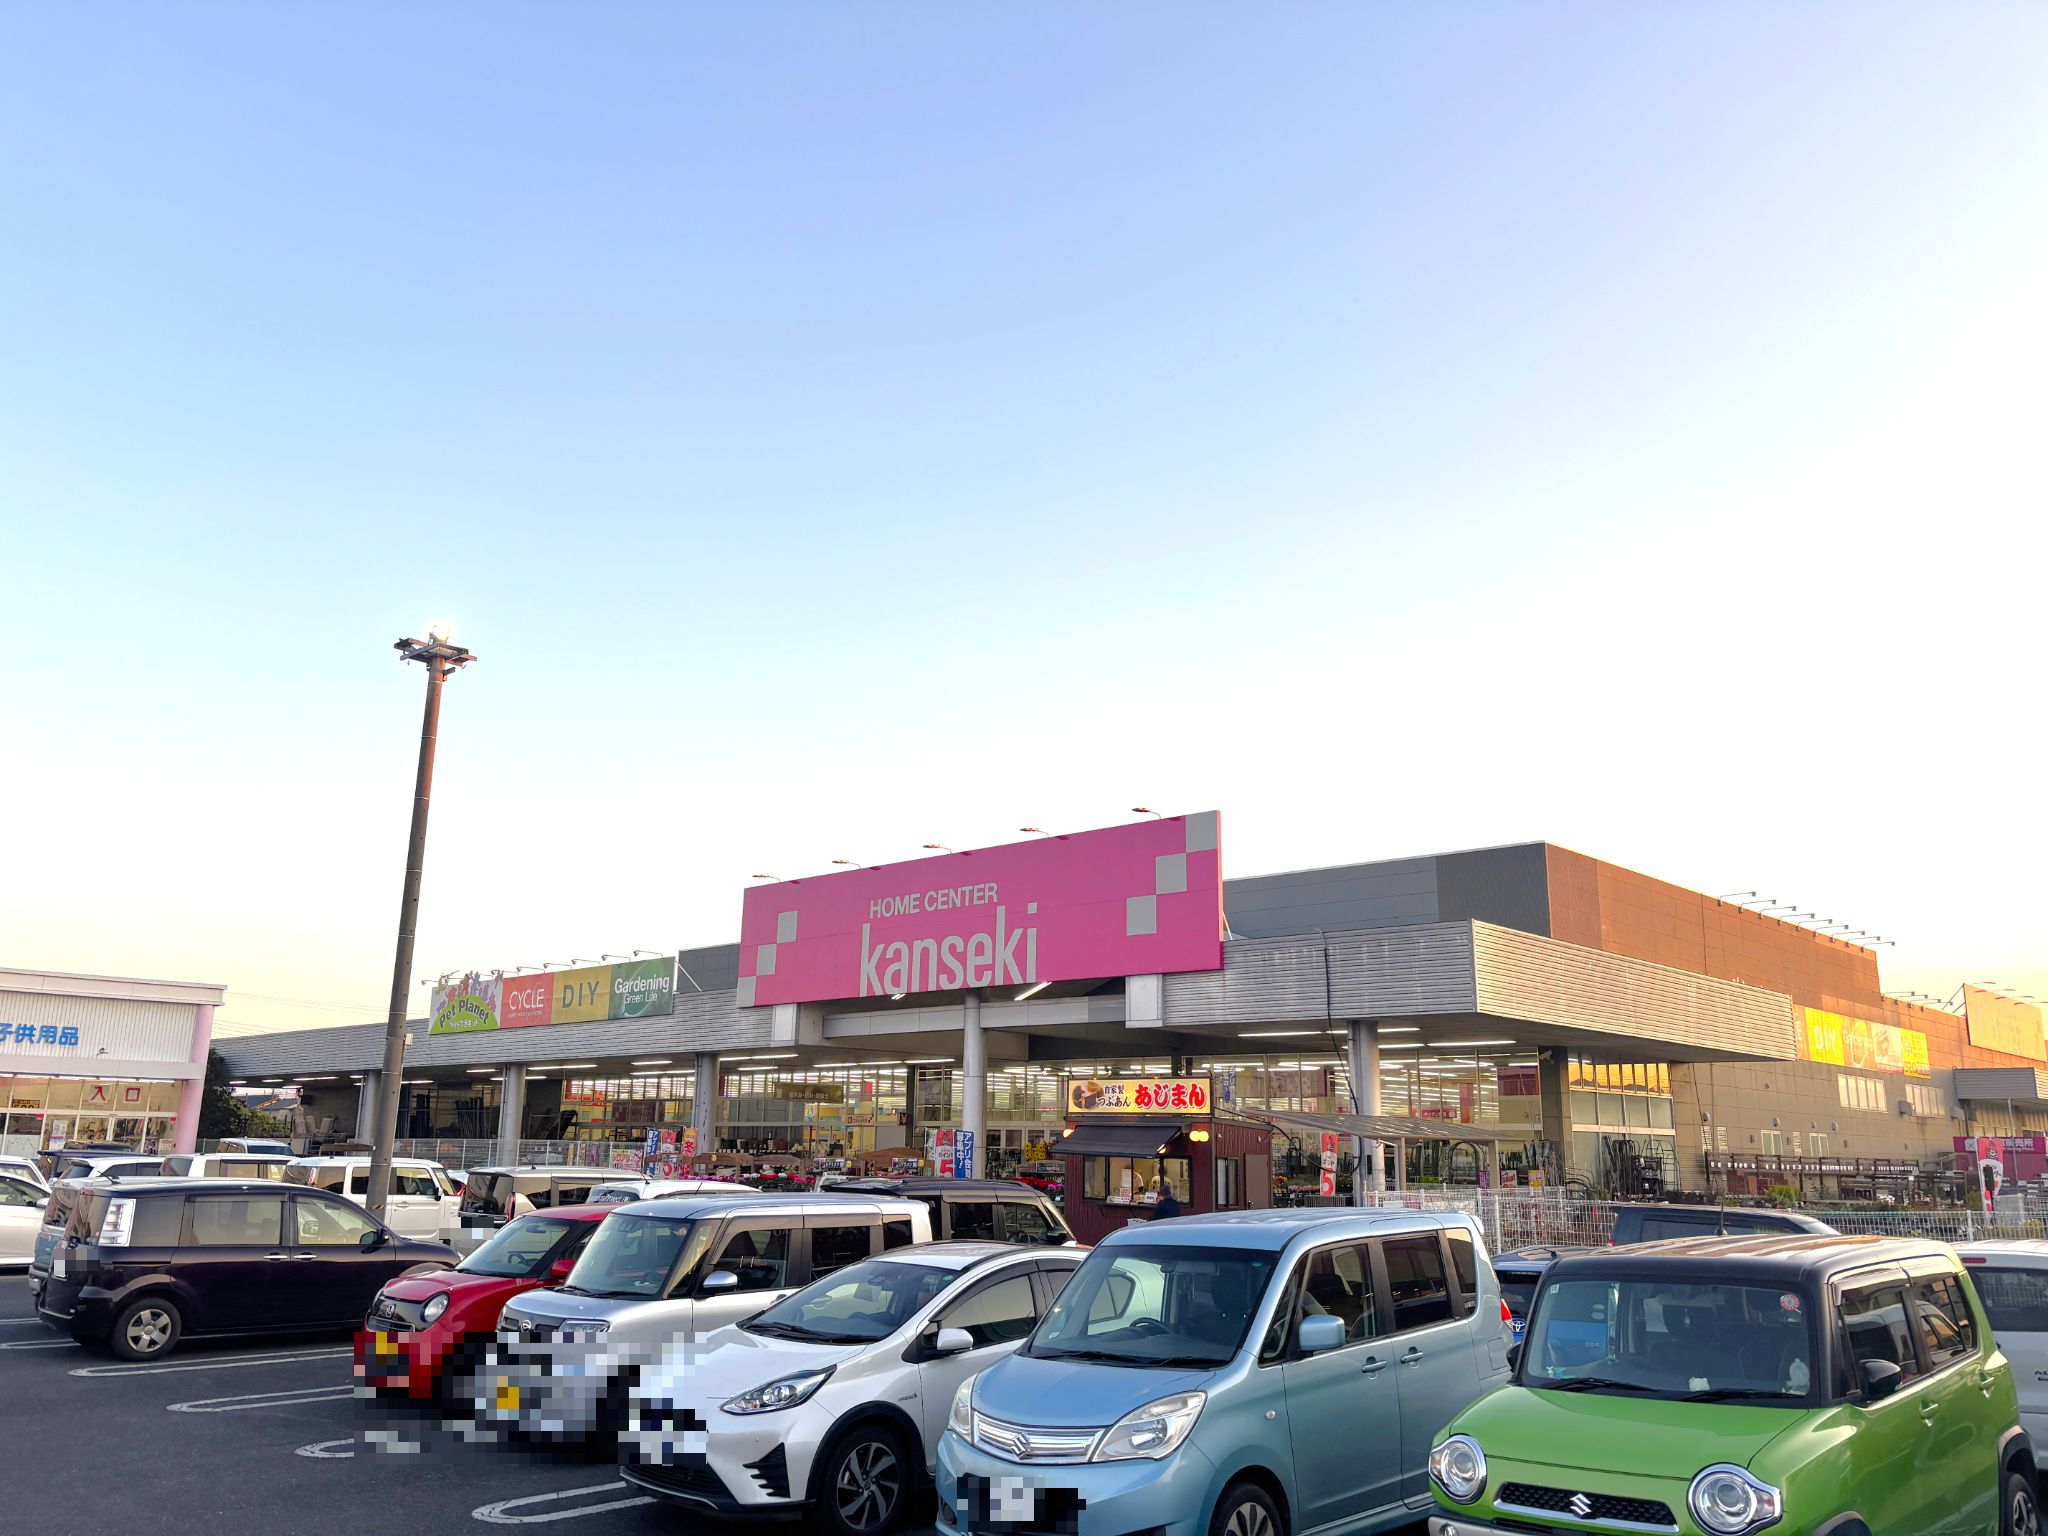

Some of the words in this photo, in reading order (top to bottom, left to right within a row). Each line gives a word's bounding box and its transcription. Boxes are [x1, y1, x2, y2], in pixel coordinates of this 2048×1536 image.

[869, 893, 921, 920] HOME
[924, 883, 998, 912] CENTER
[859, 902, 1038, 997] kanseki
[562, 980, 600, 1009] DIY
[615, 973, 670, 994] Gardening
[509, 988, 545, 1010] CYCLE
[624, 993, 645, 1004] Green
[645, 991, 658, 1003] Life
[458, 998, 490, 1025] Planet
[0, 1023, 79, 1046] 子供用品
[1814, 1025, 1836, 1051] DIY
[1104, 1084, 1125, 1095] 自家製
[1134, 1083, 1207, 1109] あじまん
[1096, 1096, 1132, 1108] つぶあん
